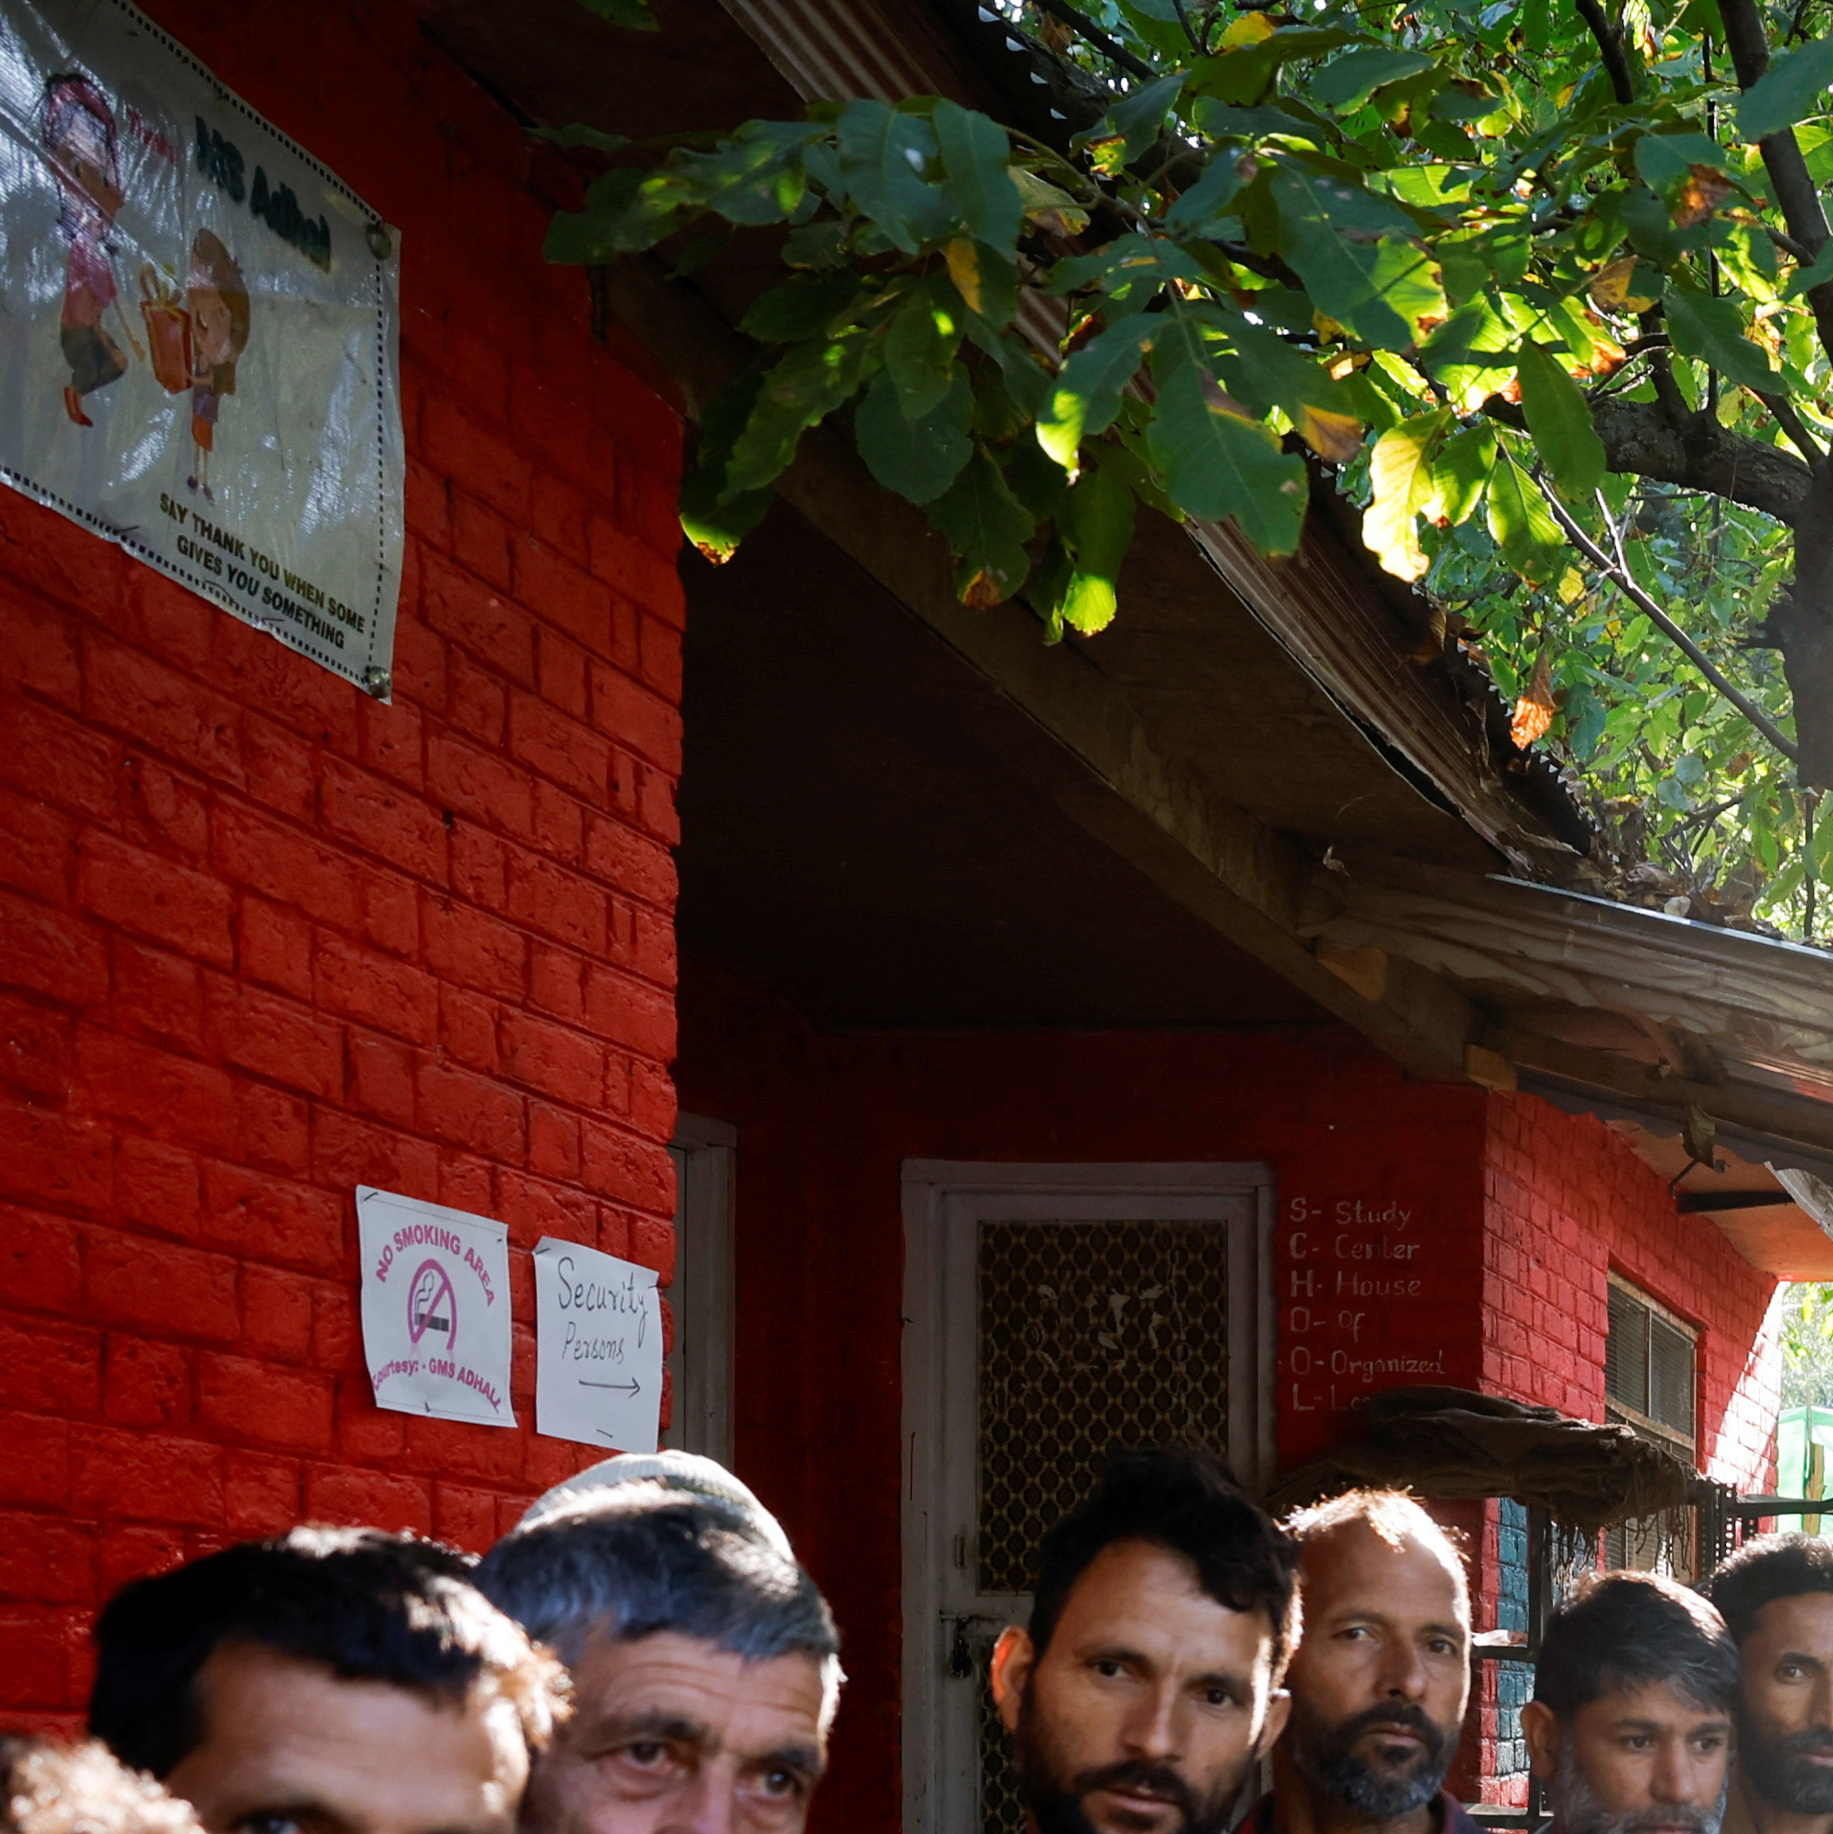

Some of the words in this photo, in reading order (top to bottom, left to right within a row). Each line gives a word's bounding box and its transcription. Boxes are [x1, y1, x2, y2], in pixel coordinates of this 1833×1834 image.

[160, 493, 188, 525] SAY
[192, 513, 246, 561] THANK
[250, 548, 280, 581] YOU
[283, 569, 325, 604] WHEN
[328, 597, 366, 634] SOME
[177, 534, 223, 576] GIVES
[227, 563, 259, 597] YOU
[263, 587, 344, 649] SOMETHING
[1335, 1199, 1411, 1231] Study
[376, 1244, 393, 1283] NO
[393, 1225, 461, 1255] SMOKING
[464, 1247, 495, 1307] AREA
[1334, 1234, 1421, 1260] Center
[558, 1256, 649, 1349] Security
[1336, 1270, 1422, 1297] House
[562, 1321, 624, 1364] Persons
[429, 1357, 456, 1378] GMS
[1331, 1349, 1446, 1383] Organized
